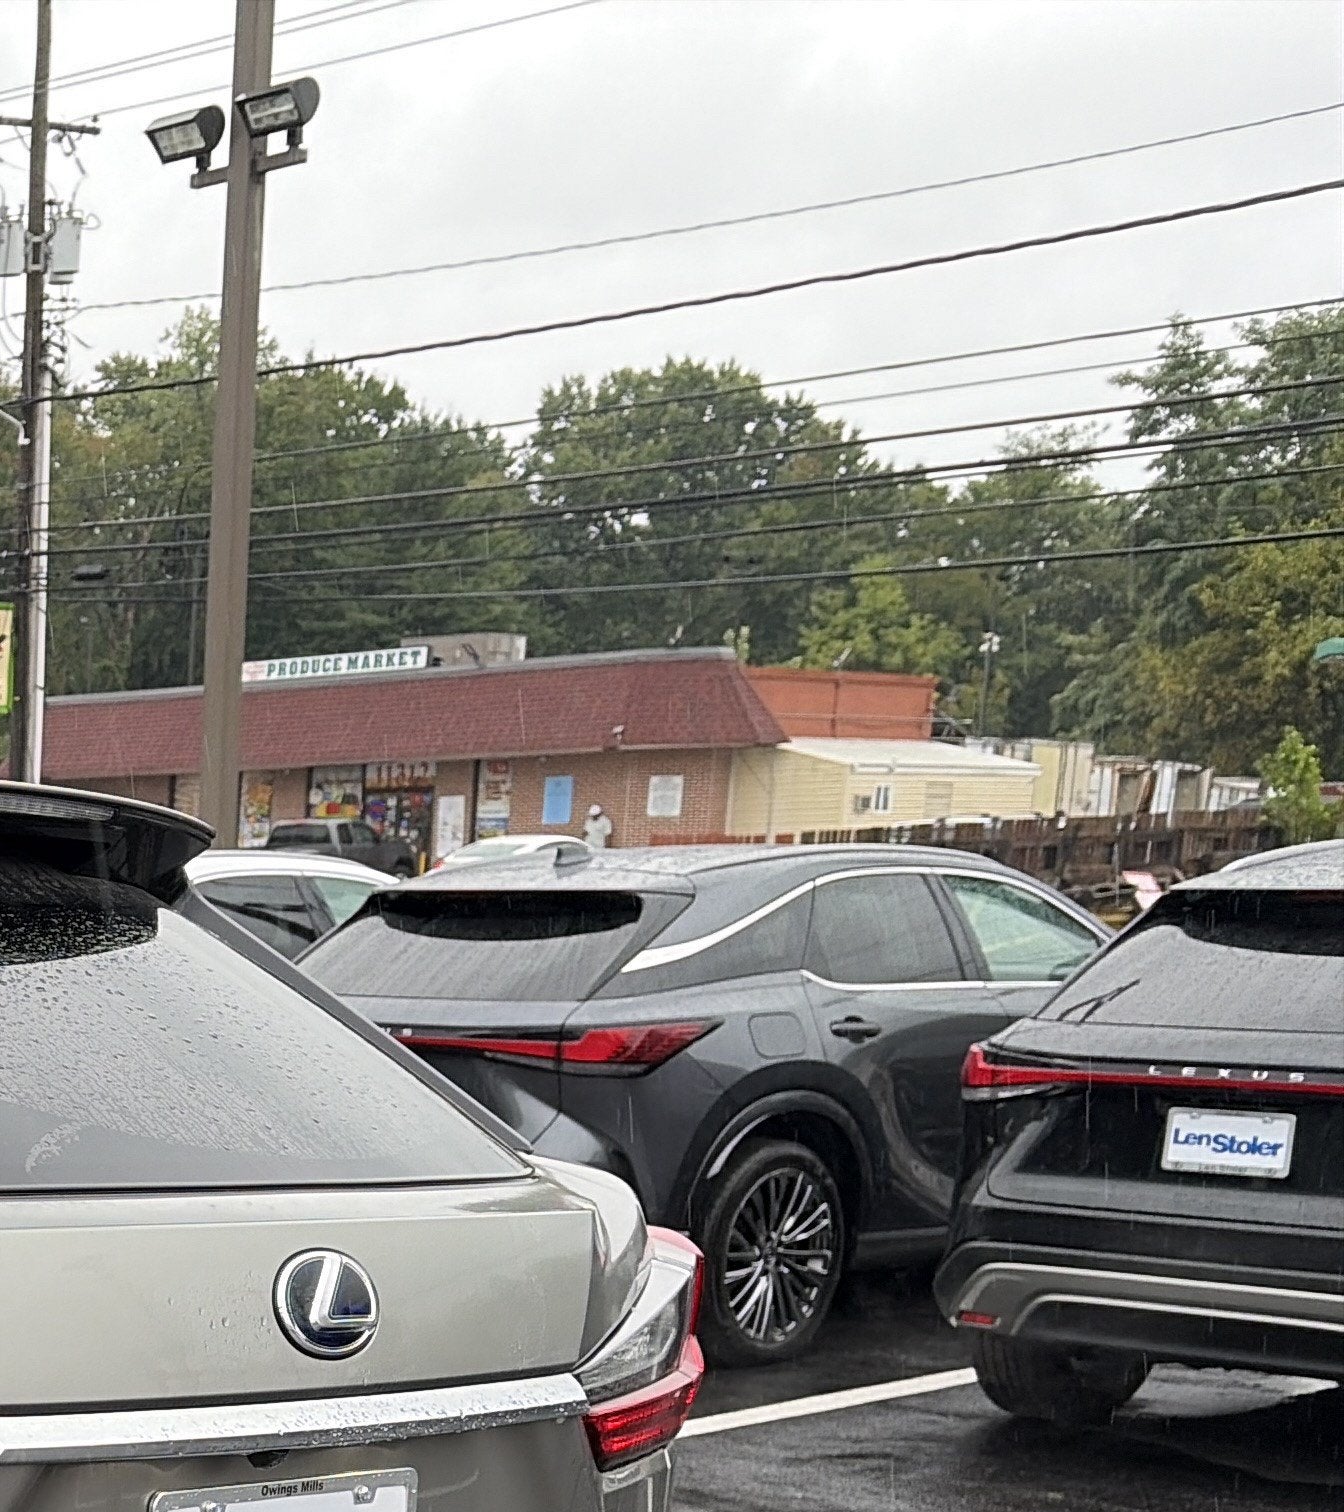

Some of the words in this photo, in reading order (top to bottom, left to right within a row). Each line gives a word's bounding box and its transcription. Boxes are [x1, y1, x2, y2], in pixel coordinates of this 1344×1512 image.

[266, 656, 342, 677] PRODUCE
[347, 650, 421, 671] MARKET
[1148, 1065, 1305, 1083] LEXUS
[1172, 1126, 1284, 1157] LenStoler
[261, 1483, 298, 1497] Owings
[300, 1480, 324, 1493] Mills
